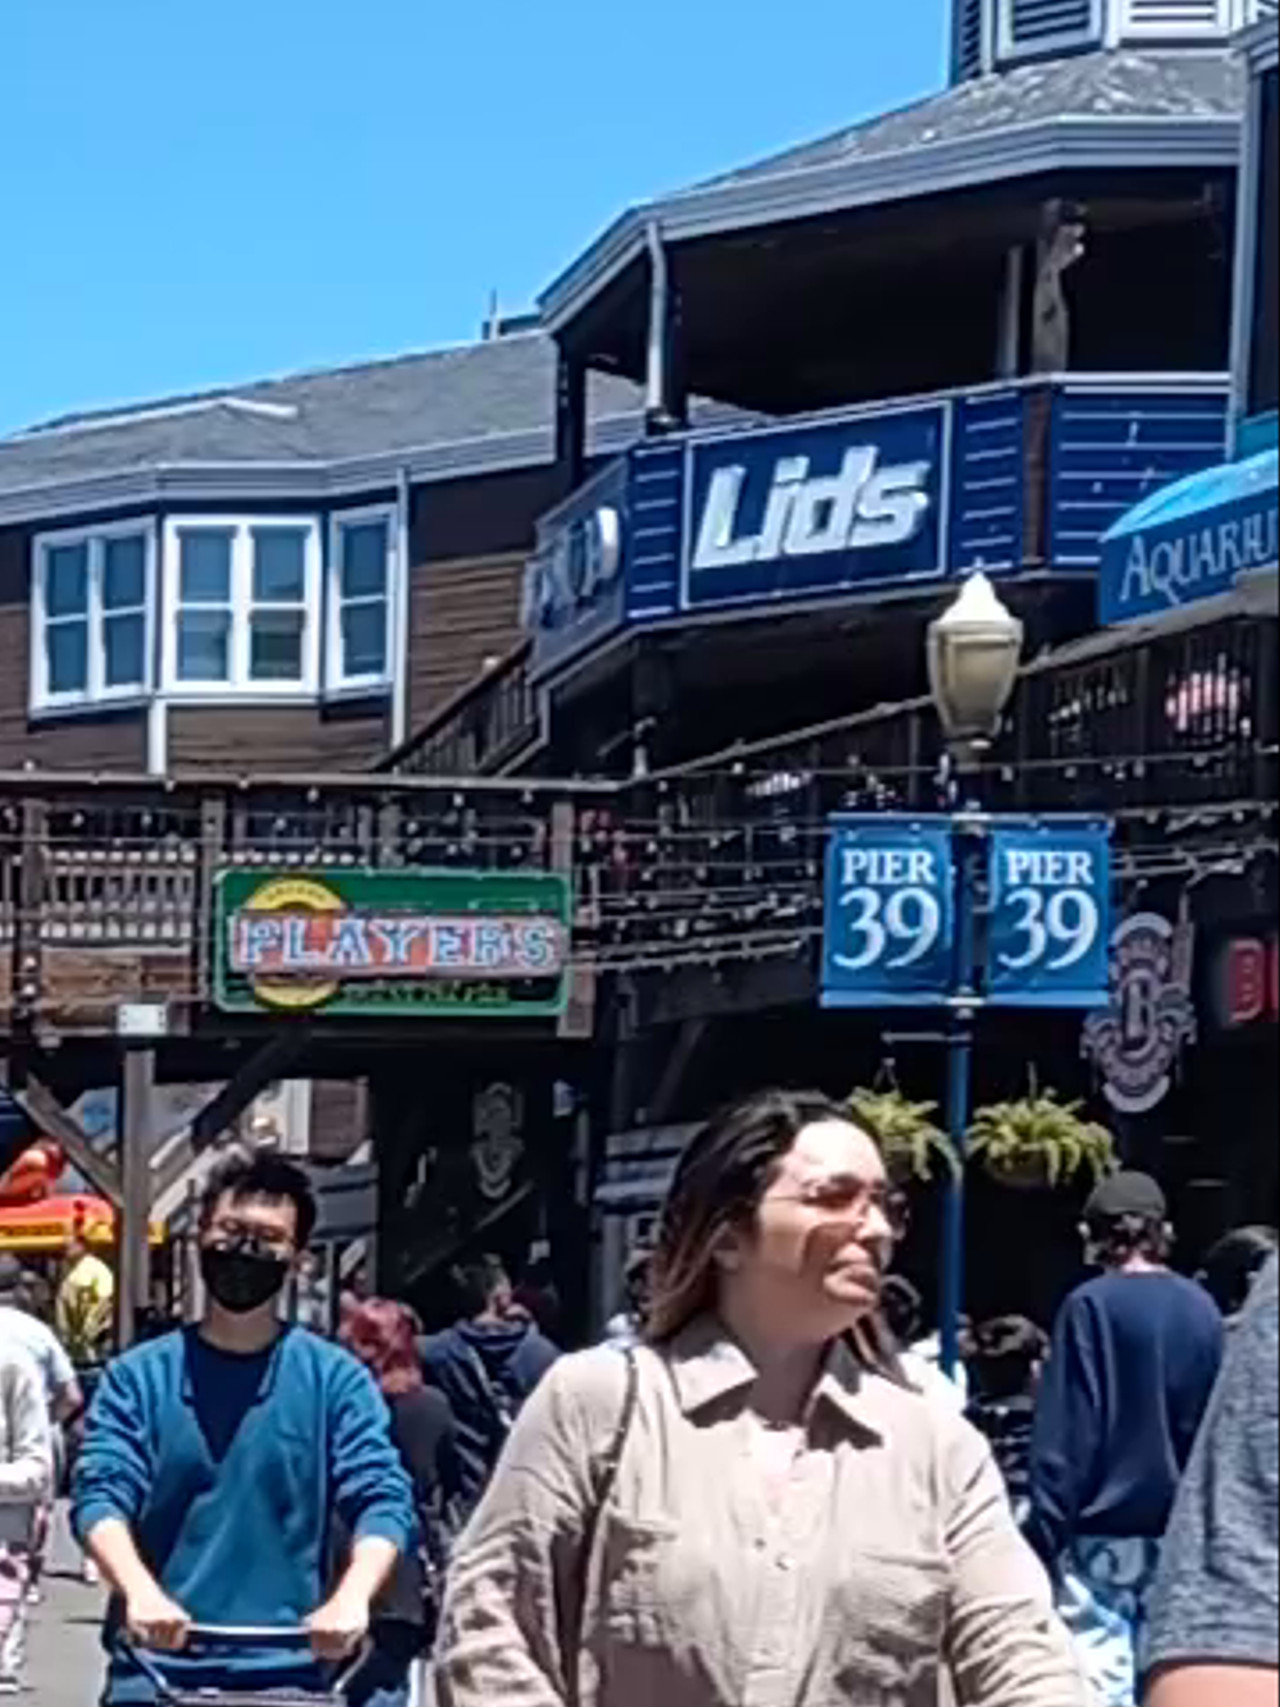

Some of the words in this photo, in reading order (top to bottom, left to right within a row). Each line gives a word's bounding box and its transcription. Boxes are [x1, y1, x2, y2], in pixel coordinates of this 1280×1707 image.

[692, 445, 931, 569] Lids
[841, 848, 937, 885] PIER
[1005, 849, 1095, 885] PIER
[239, 914, 556, 970] PLAYERS
[832, 886, 940, 970] 39
[997, 886, 1099, 970] 39
